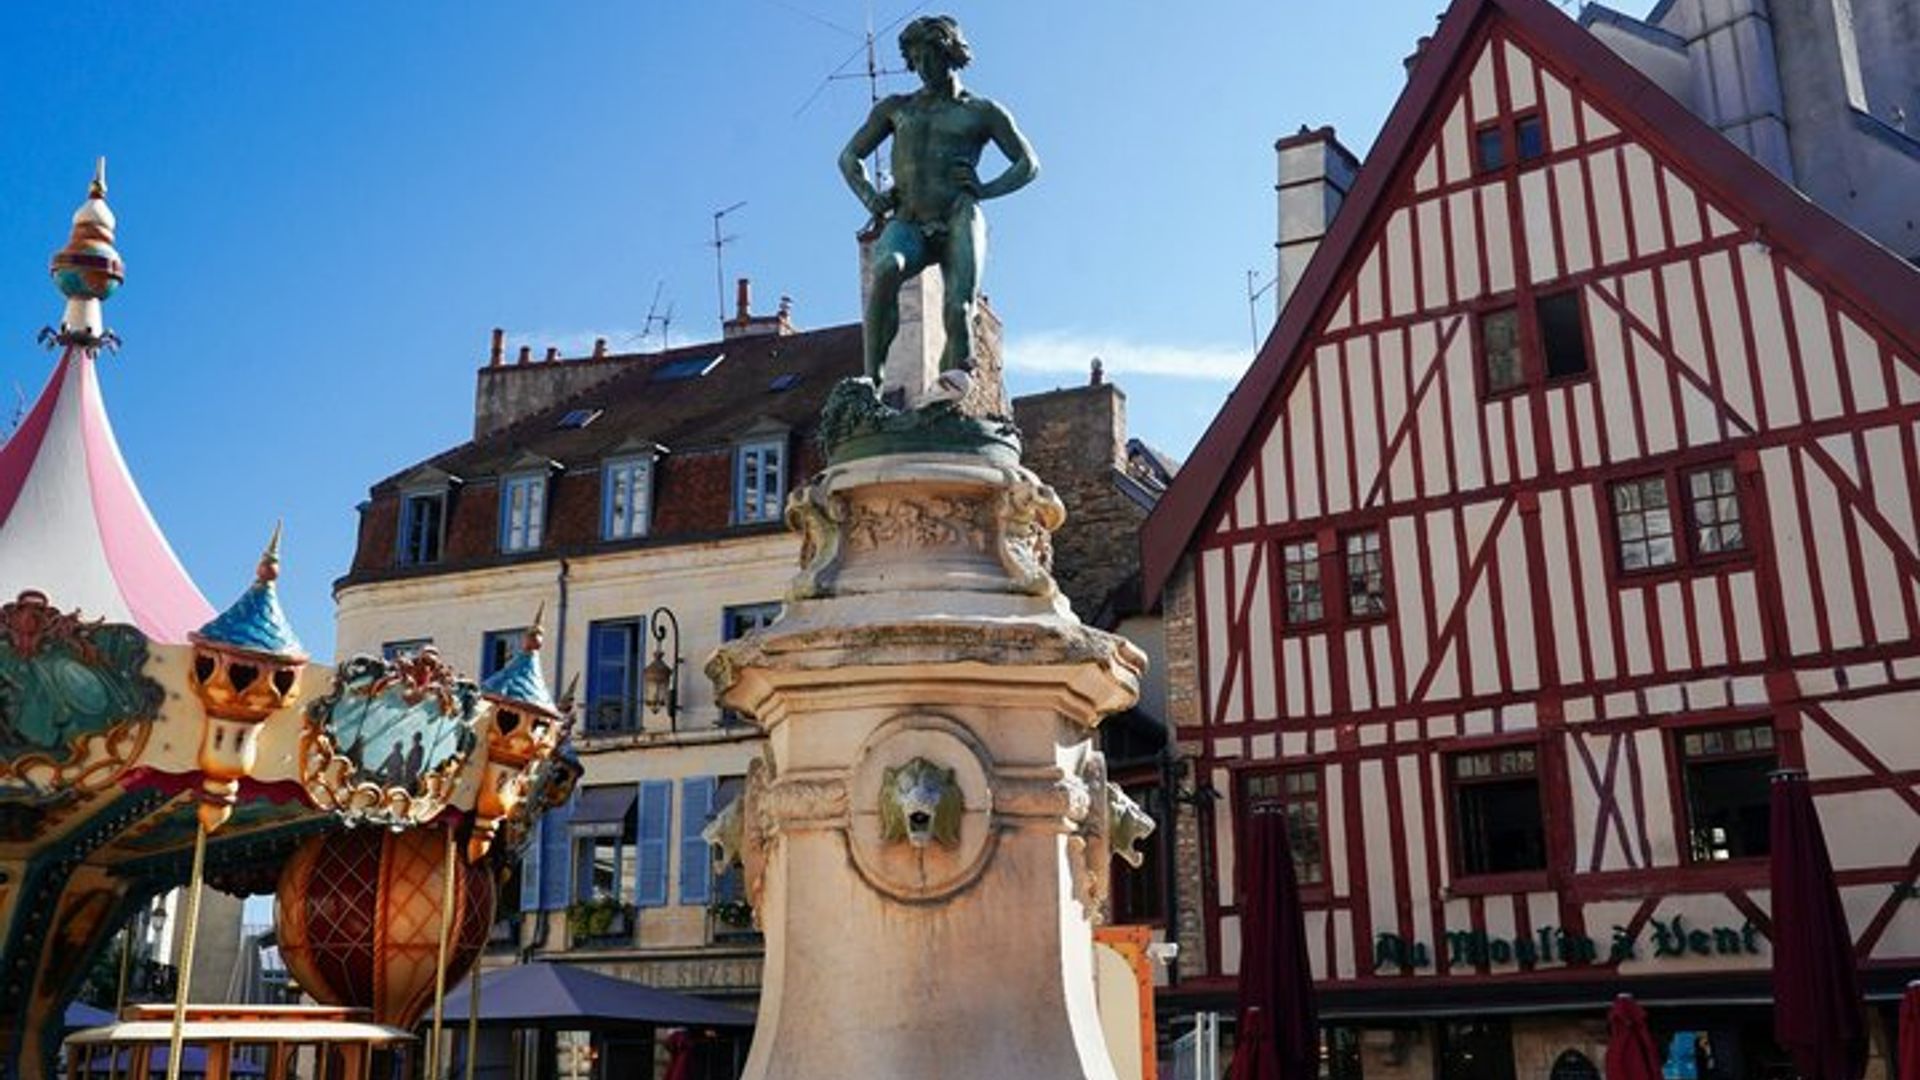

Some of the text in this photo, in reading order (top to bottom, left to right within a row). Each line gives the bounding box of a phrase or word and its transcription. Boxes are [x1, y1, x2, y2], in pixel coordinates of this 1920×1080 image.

[1373, 913, 1760, 969] Au Moulin à Vent
